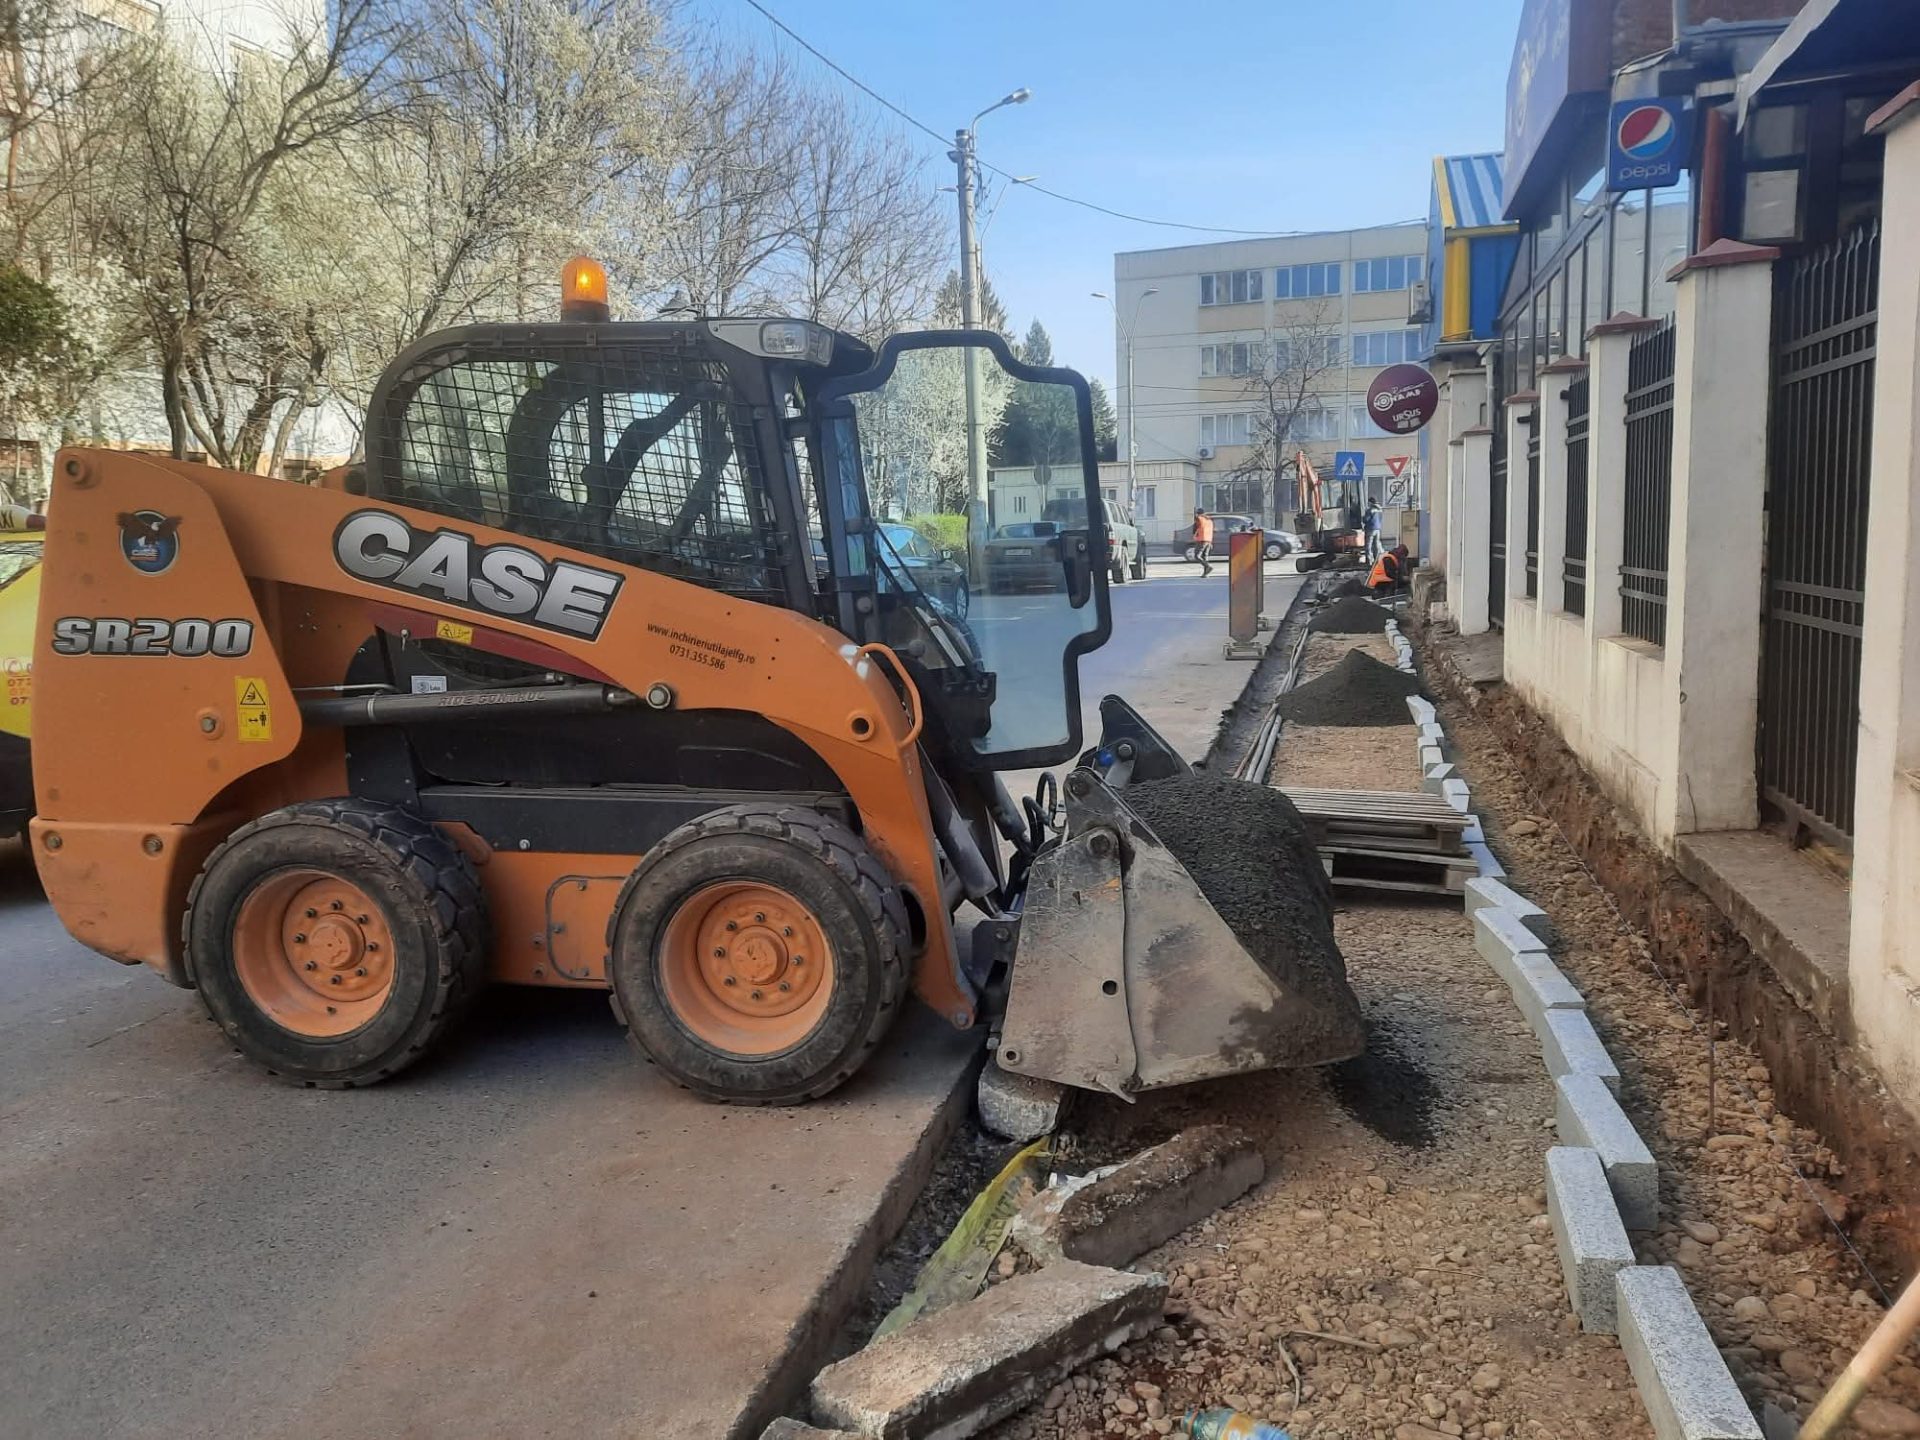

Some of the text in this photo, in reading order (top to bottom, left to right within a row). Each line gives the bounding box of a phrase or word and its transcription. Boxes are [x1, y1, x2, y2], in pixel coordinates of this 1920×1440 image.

[1619, 162, 1671, 181] pepsi
[1392, 408, 1422, 422] URSUS
[336, 511, 620, 638] CASE
[52, 616, 254, 658] SR200
[669, 644, 726, 670] 0731.355.586
[438, 691, 547, 707] RIDE CONTROL
